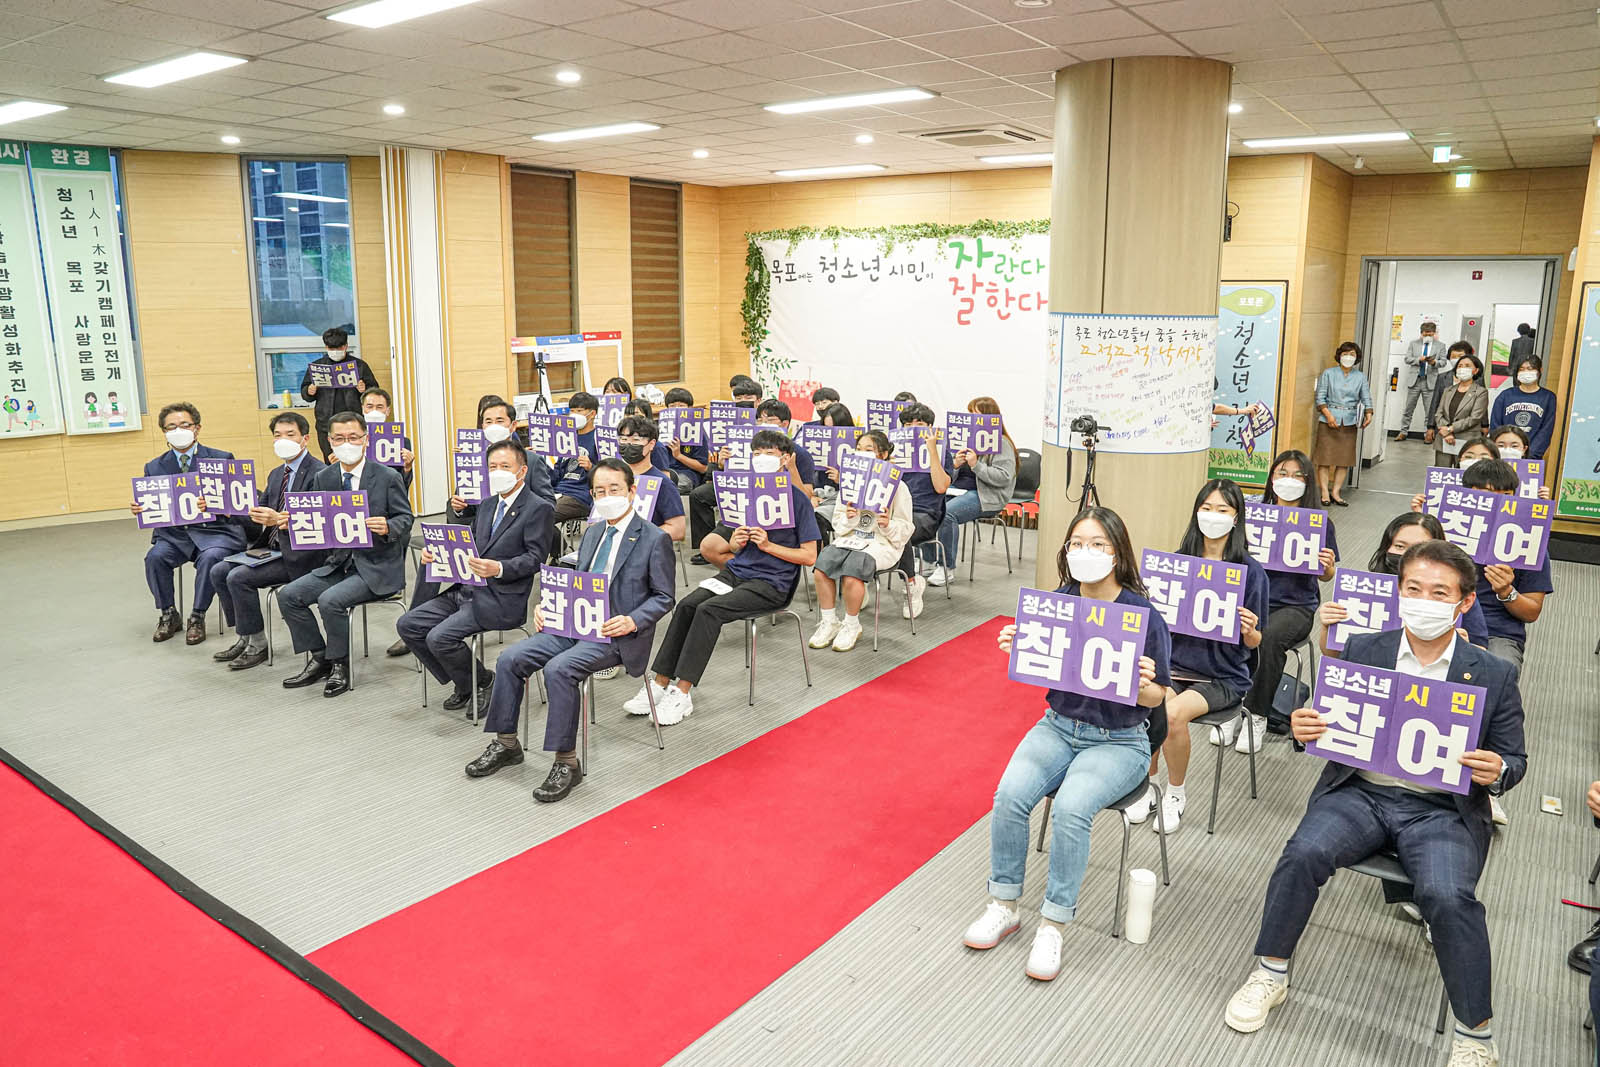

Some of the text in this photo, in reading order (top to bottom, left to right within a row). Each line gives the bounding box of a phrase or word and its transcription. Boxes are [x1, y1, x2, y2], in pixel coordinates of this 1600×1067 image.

[0, 143, 20, 160] 사
[51, 148, 90, 165] 환경
[819, 255, 880, 284] 청소년
[948, 238, 1046, 283] 자란다
[56, 188, 96, 382] 청소년 목포 사랑운동
[948, 273, 1049, 325] 잘한다
[1075, 326, 1092, 341] 목포
[1097, 326, 1150, 343] 청소년들의
[1232, 321, 1254, 393] 청소년
[312, 371, 358, 387] 참여
[712, 409, 749, 419] 청소년 시
[869, 402, 904, 412] 청소년 시
[530, 415, 551, 426] 청소년
[869, 412, 892, 432] 참
[948, 414, 971, 424] 청소년
[530, 427, 577, 456] 참여
[659, 420, 700, 444] 참여
[728, 428, 753, 439] 청소년
[805, 428, 832, 439] 청소년
[948, 426, 999, 452] 참여
[456, 455, 482, 467] 청소년
[598, 440, 618, 459] 참
[728, 441, 752, 470] 참
[199, 462, 224, 475] 청소년
[842, 457, 869, 471] 청소년
[135, 478, 170, 492] 청소년
[457, 470, 483, 500] 참
[716, 476, 749, 488] 청소년
[841, 471, 895, 513] 참여
[201, 477, 255, 511] 참여
[288, 495, 323, 508] 청소년
[1446, 490, 1494, 512] 청소년
[719, 490, 791, 527] 참여
[1244, 507, 1279, 523] 청소년
[291, 511, 368, 545] 참여
[422, 527, 445, 541] 청소년
[1441, 510, 1544, 566] 참여
[1245, 523, 1321, 571] 참여
[1145, 554, 1190, 577] 청소년
[540, 568, 568, 587] 청소년
[1340, 574, 1393, 597] 청소년
[540, 588, 606, 639] 참여
[1022, 594, 1075, 621] 청소년
[1142, 576, 1238, 638] 참여
[1335, 597, 1390, 643] 참
[1016, 620, 1137, 698] 참여
[1324, 664, 1393, 699] 청소년
[1316, 694, 1470, 786] 참여
